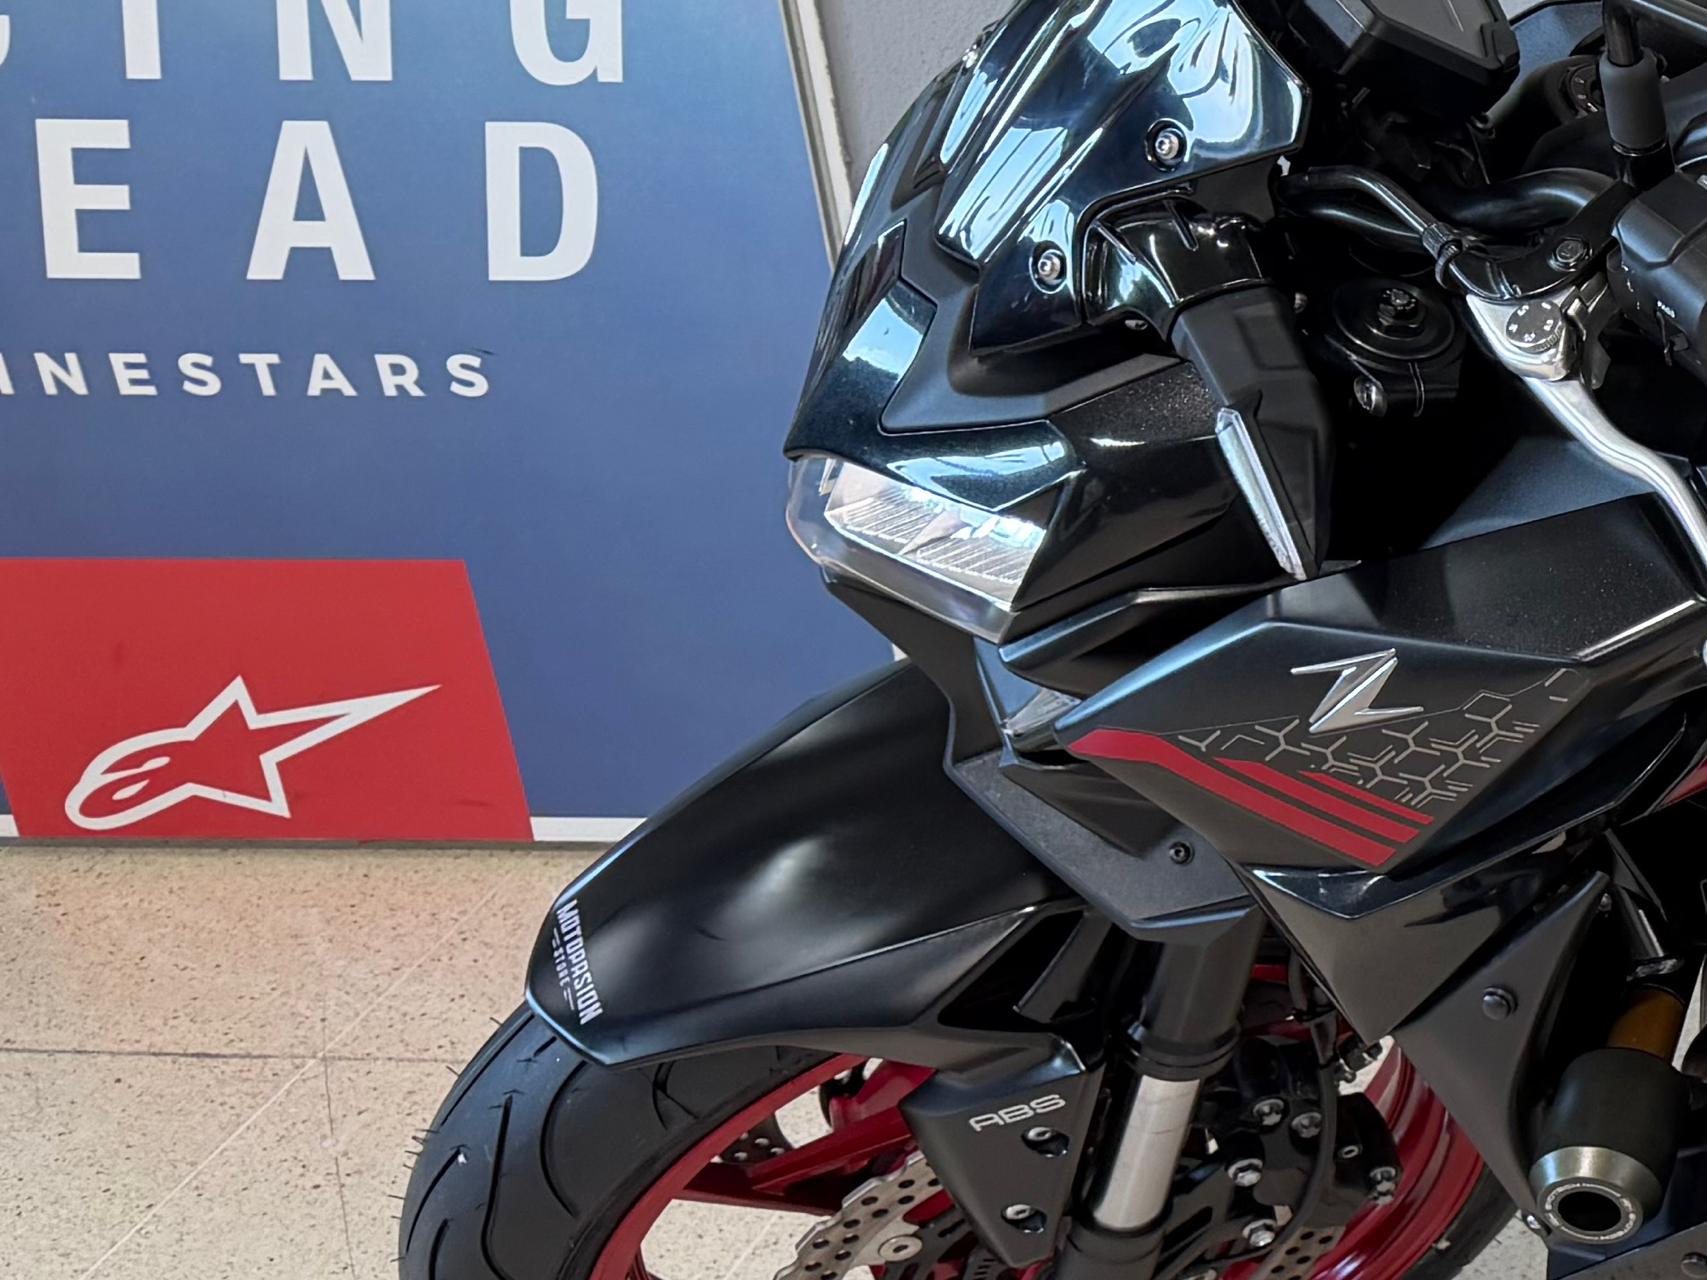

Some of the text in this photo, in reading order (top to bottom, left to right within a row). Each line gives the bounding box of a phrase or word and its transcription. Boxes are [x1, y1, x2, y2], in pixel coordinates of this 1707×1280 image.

[34, 118, 600, 283] EAD
[1290, 647, 1424, 735] Z
[553, 946, 571, 987] STORE
[556, 898, 603, 1025] MOTOPASION
[968, 1094, 1066, 1132] ABS
